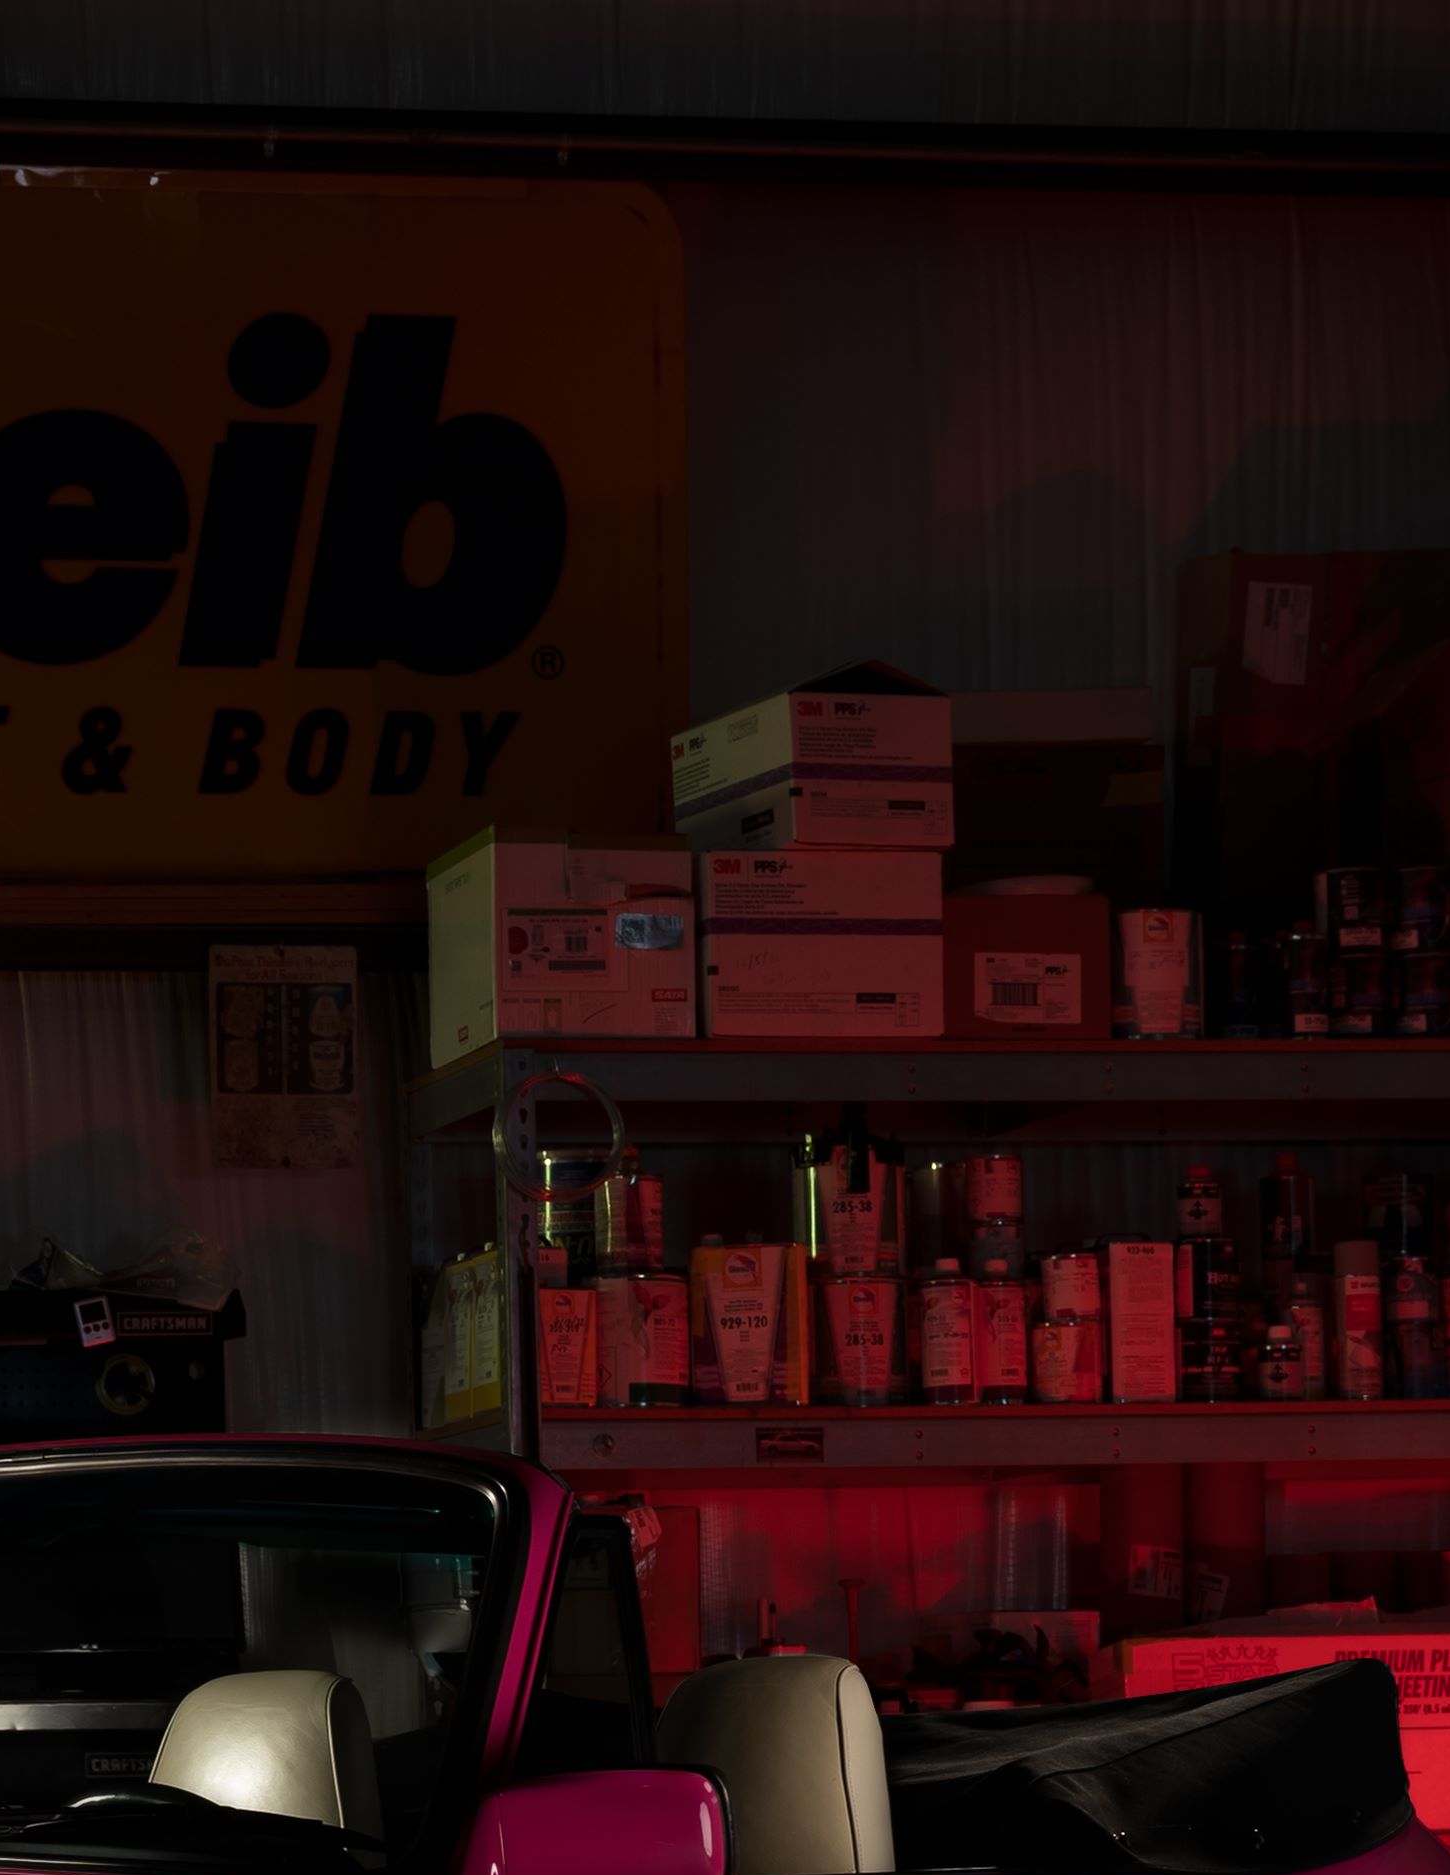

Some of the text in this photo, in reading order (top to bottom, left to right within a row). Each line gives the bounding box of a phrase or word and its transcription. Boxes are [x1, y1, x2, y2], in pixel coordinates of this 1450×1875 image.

[797, 701, 822, 717] 3M
[60, 704, 133, 797] &
[198, 705, 524, 798] BODY
[713, 858, 741, 875] 3M
[653, 990, 686, 1001] SATA
[832, 1199, 873, 1214] 285-38
[719, 1315, 769, 1329] 929-120
[844, 1333, 885, 1347] 285-38
[1172, 1651, 1206, 1682] 5
